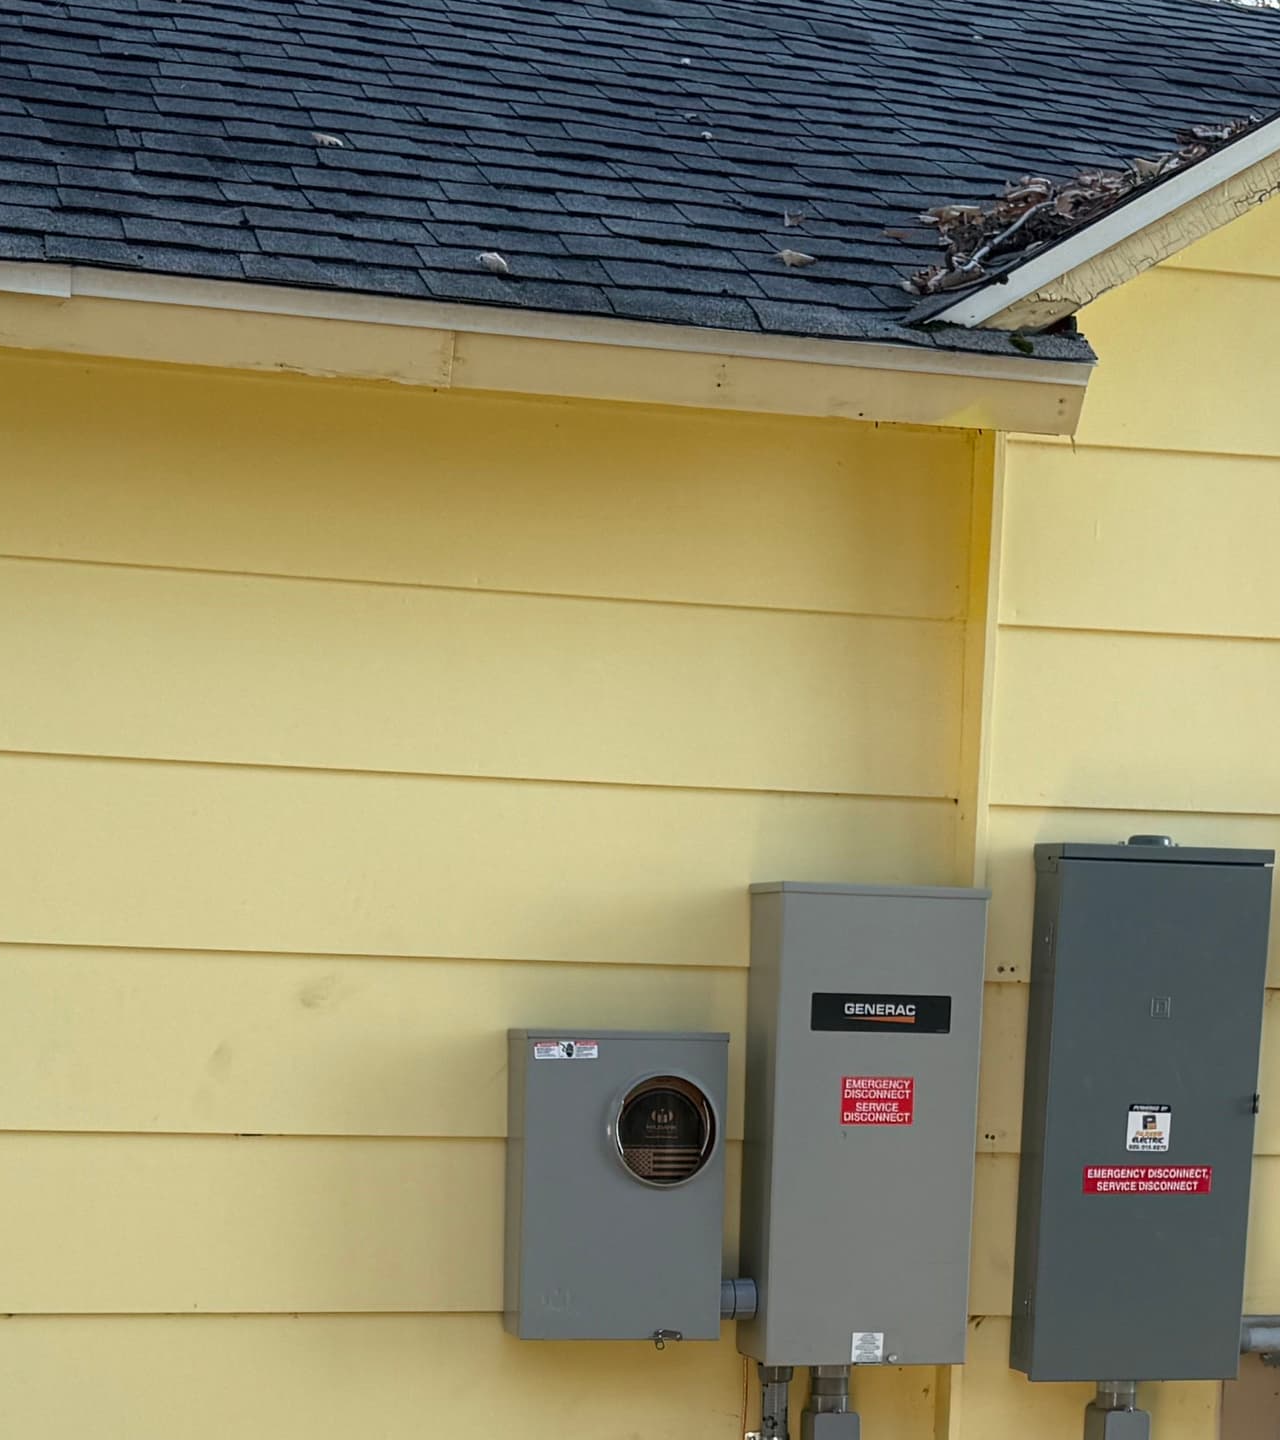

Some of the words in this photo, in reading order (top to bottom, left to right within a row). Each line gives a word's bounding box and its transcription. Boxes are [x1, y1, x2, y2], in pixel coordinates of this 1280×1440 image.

[844, 1003, 916, 1016] GENERAC
[845, 1079, 911, 1089] EMERGENCY
[844, 1089, 911, 1099] DISCONNECT
[855, 1102, 899, 1112] SERVICE
[843, 1112, 910, 1122] DISCONNECT
[1087, 1168, 1146, 1178] EMERGENCY
[1096, 1181, 1137, 1191] SERVICE
[1138, 1181, 1199, 1191] DISCONNECT
